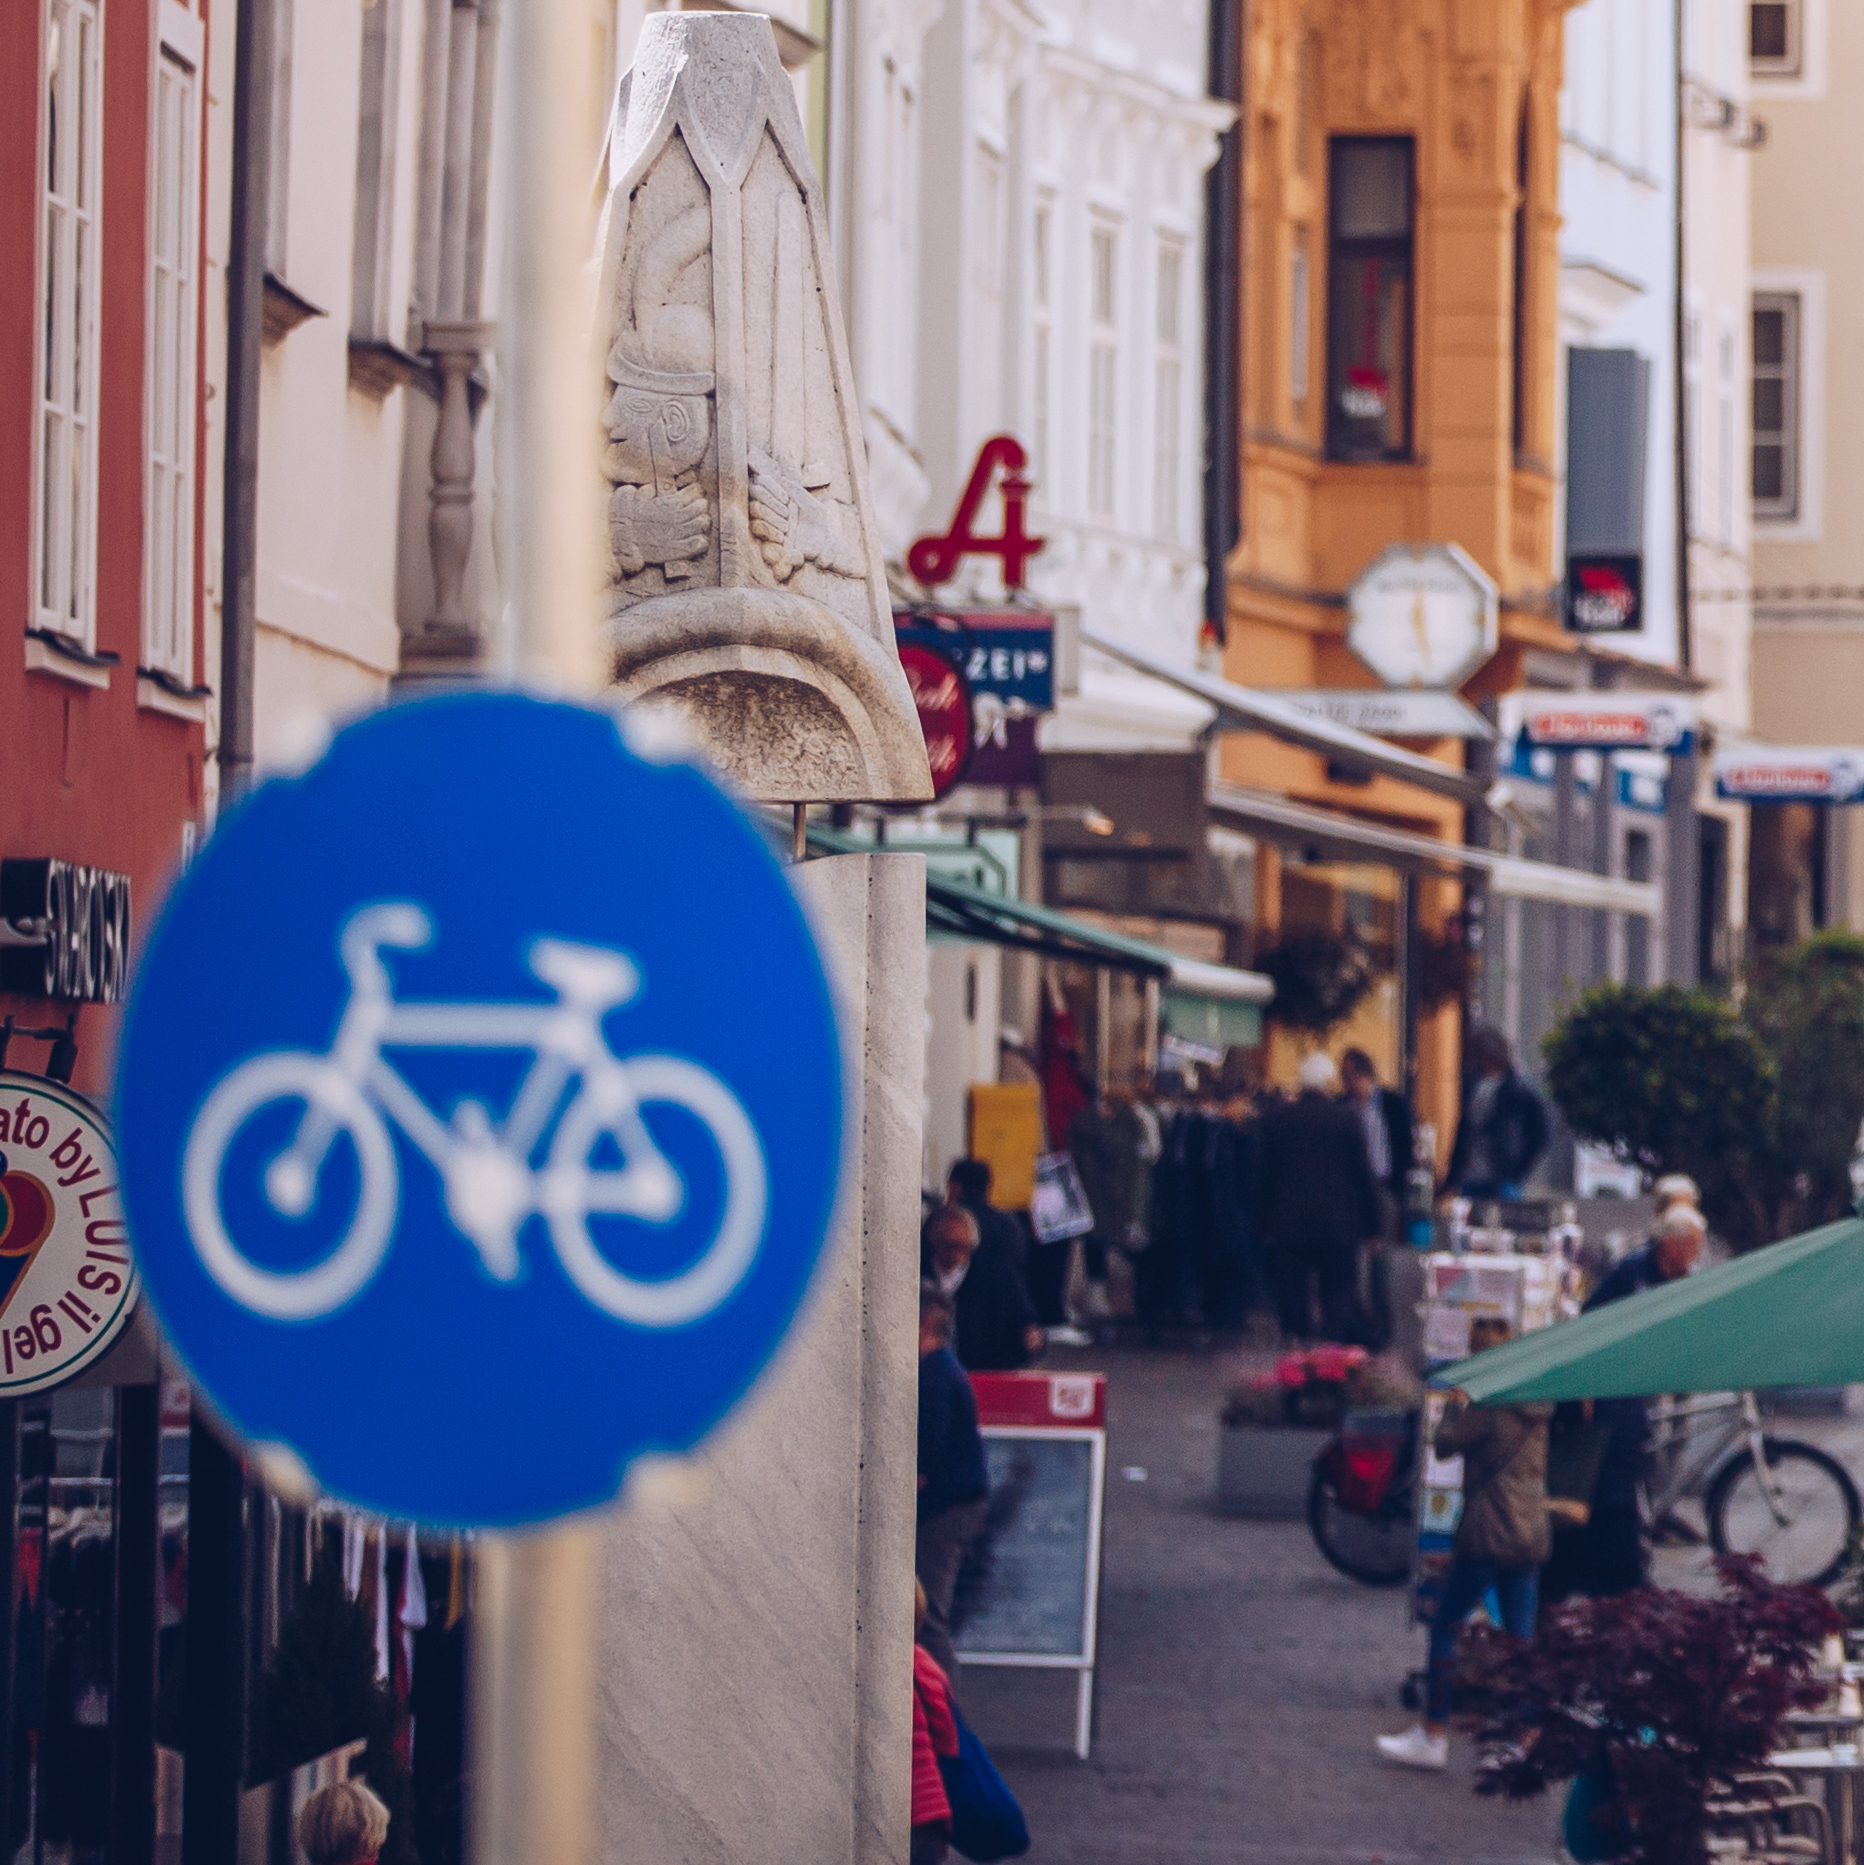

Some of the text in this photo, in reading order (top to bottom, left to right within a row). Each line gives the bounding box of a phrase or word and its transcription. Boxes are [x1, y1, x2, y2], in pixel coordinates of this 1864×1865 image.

[49, 1127, 101, 1187] by
[77, 1183, 130, 1296] LUIS
[57, 1290, 102, 1334] il
